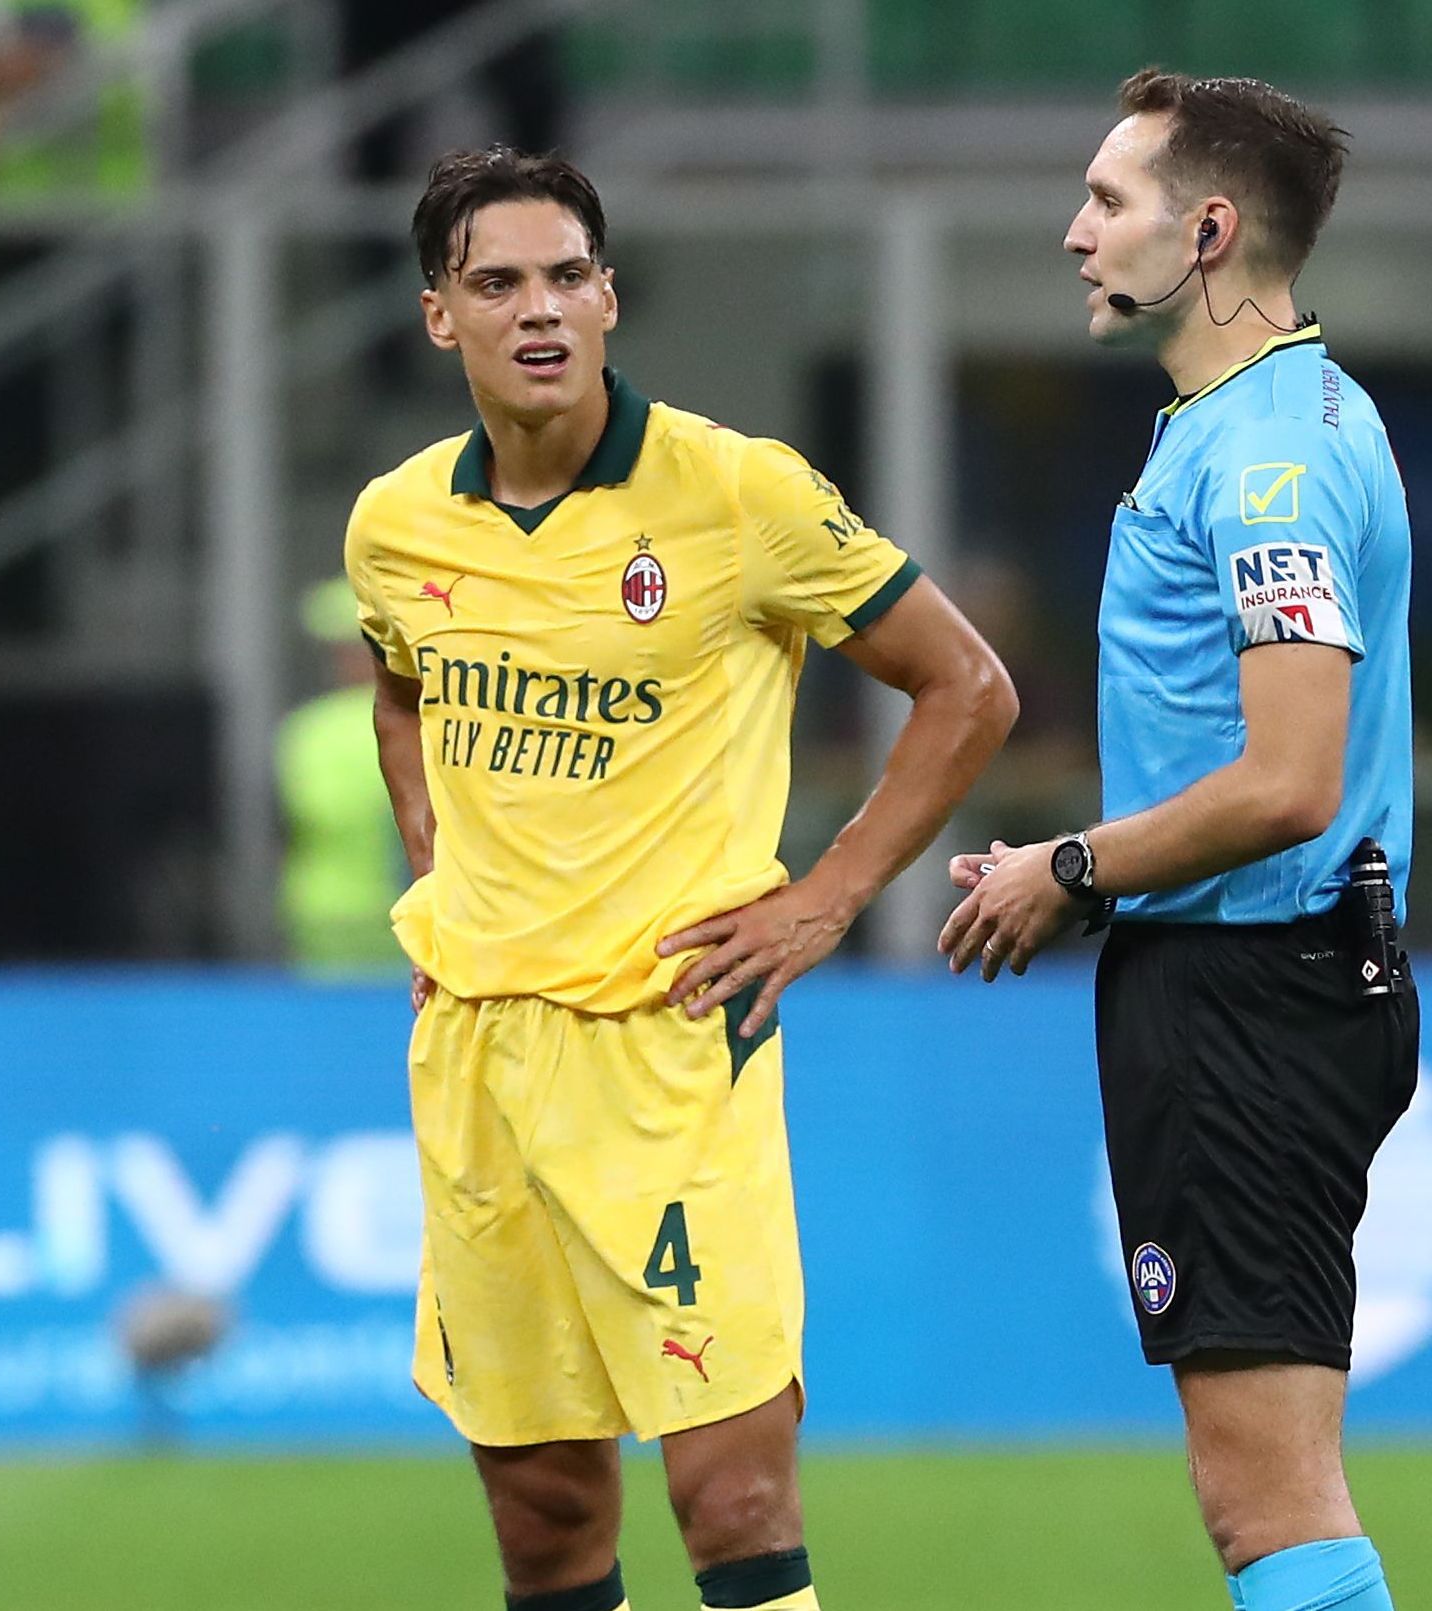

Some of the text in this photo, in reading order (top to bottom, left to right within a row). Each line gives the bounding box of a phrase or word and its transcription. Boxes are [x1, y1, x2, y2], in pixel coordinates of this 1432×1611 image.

[1235, 548, 1323, 592] NET
[1240, 586, 1333, 610] INSURANCE
[418, 646, 663, 724] Emirates
[442, 718, 615, 780] FLY BETTER
[643, 1201, 701, 1306] 4
[1140, 1261, 1168, 1288] AIA
